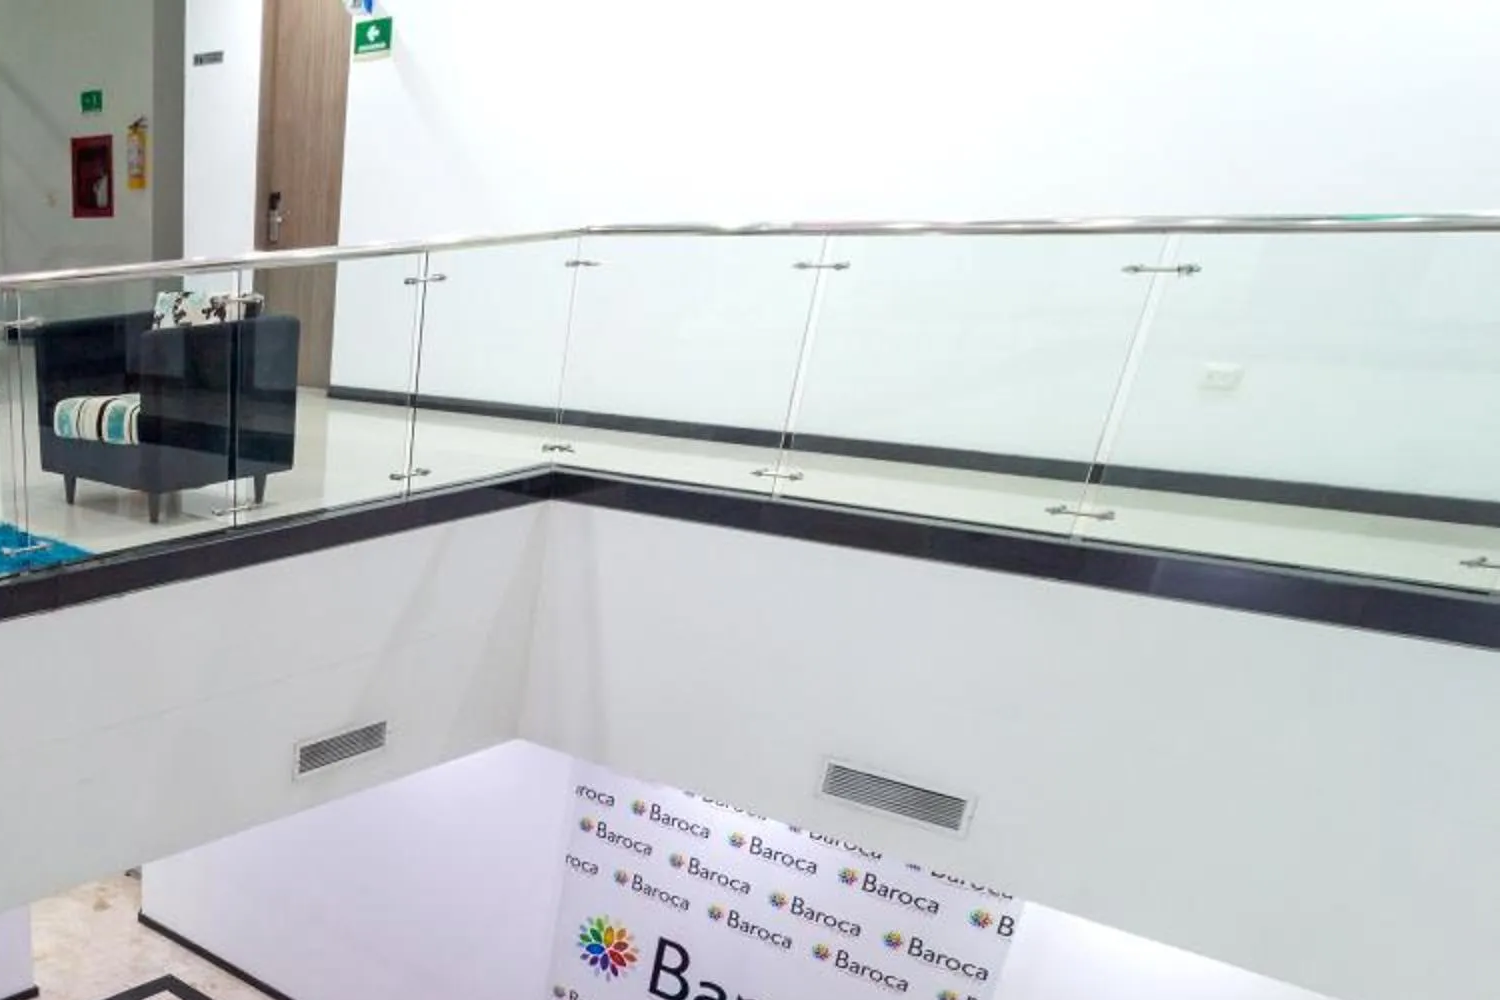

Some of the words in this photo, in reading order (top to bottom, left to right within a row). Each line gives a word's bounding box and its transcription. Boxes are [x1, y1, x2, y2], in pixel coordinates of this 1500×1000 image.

[596, 821, 653, 856] Baroca
[687, 857, 751, 894] Baroca
[789, 896, 861, 937] Baroca
[907, 936, 989, 981] Baroca
[650, 803, 710, 839] Baroca
[750, 836, 818, 875] Baroca
[861, 872, 940, 914] Baroca
[631, 874, 691, 911] Baroca
[727, 911, 793, 950] Baroca
[835, 949, 909, 993] Baroca
